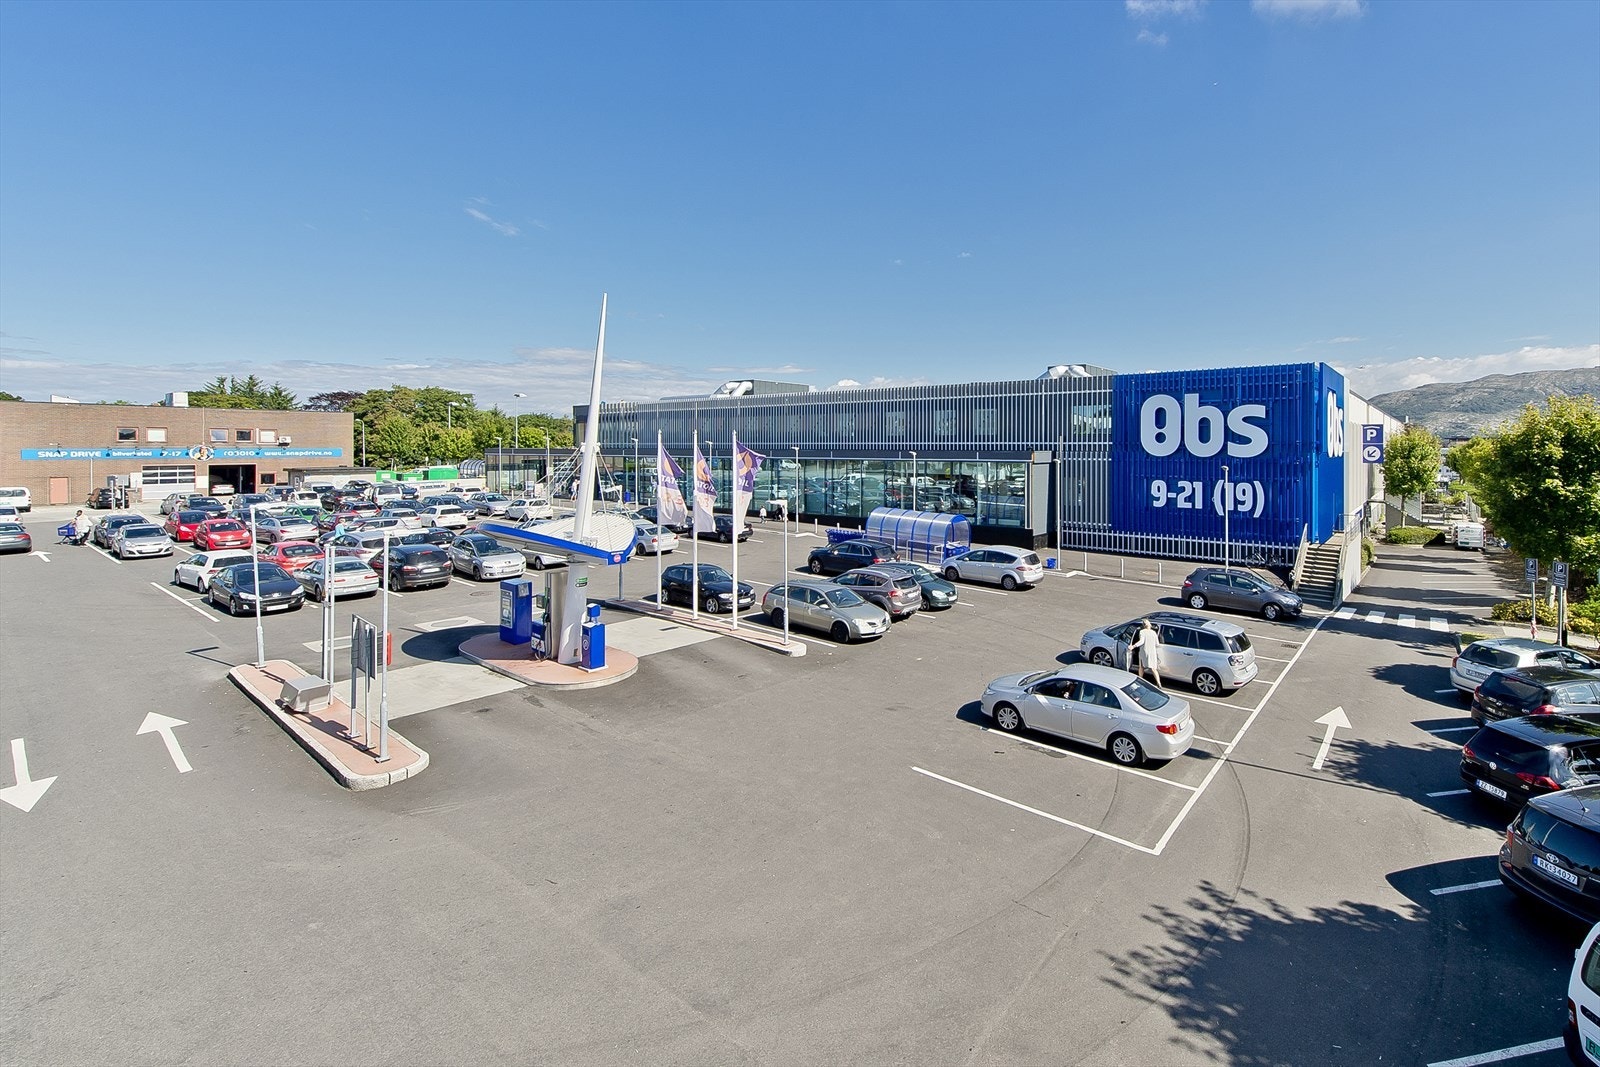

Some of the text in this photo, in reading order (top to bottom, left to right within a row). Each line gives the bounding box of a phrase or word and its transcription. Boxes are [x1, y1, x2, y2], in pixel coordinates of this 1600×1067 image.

[1140, 393, 1269, 458] Obs
[1366, 429, 1377, 441] P
[70, 450, 101, 458] DRIVE
[1150, 479, 1265, 518] 9-21 (19)
